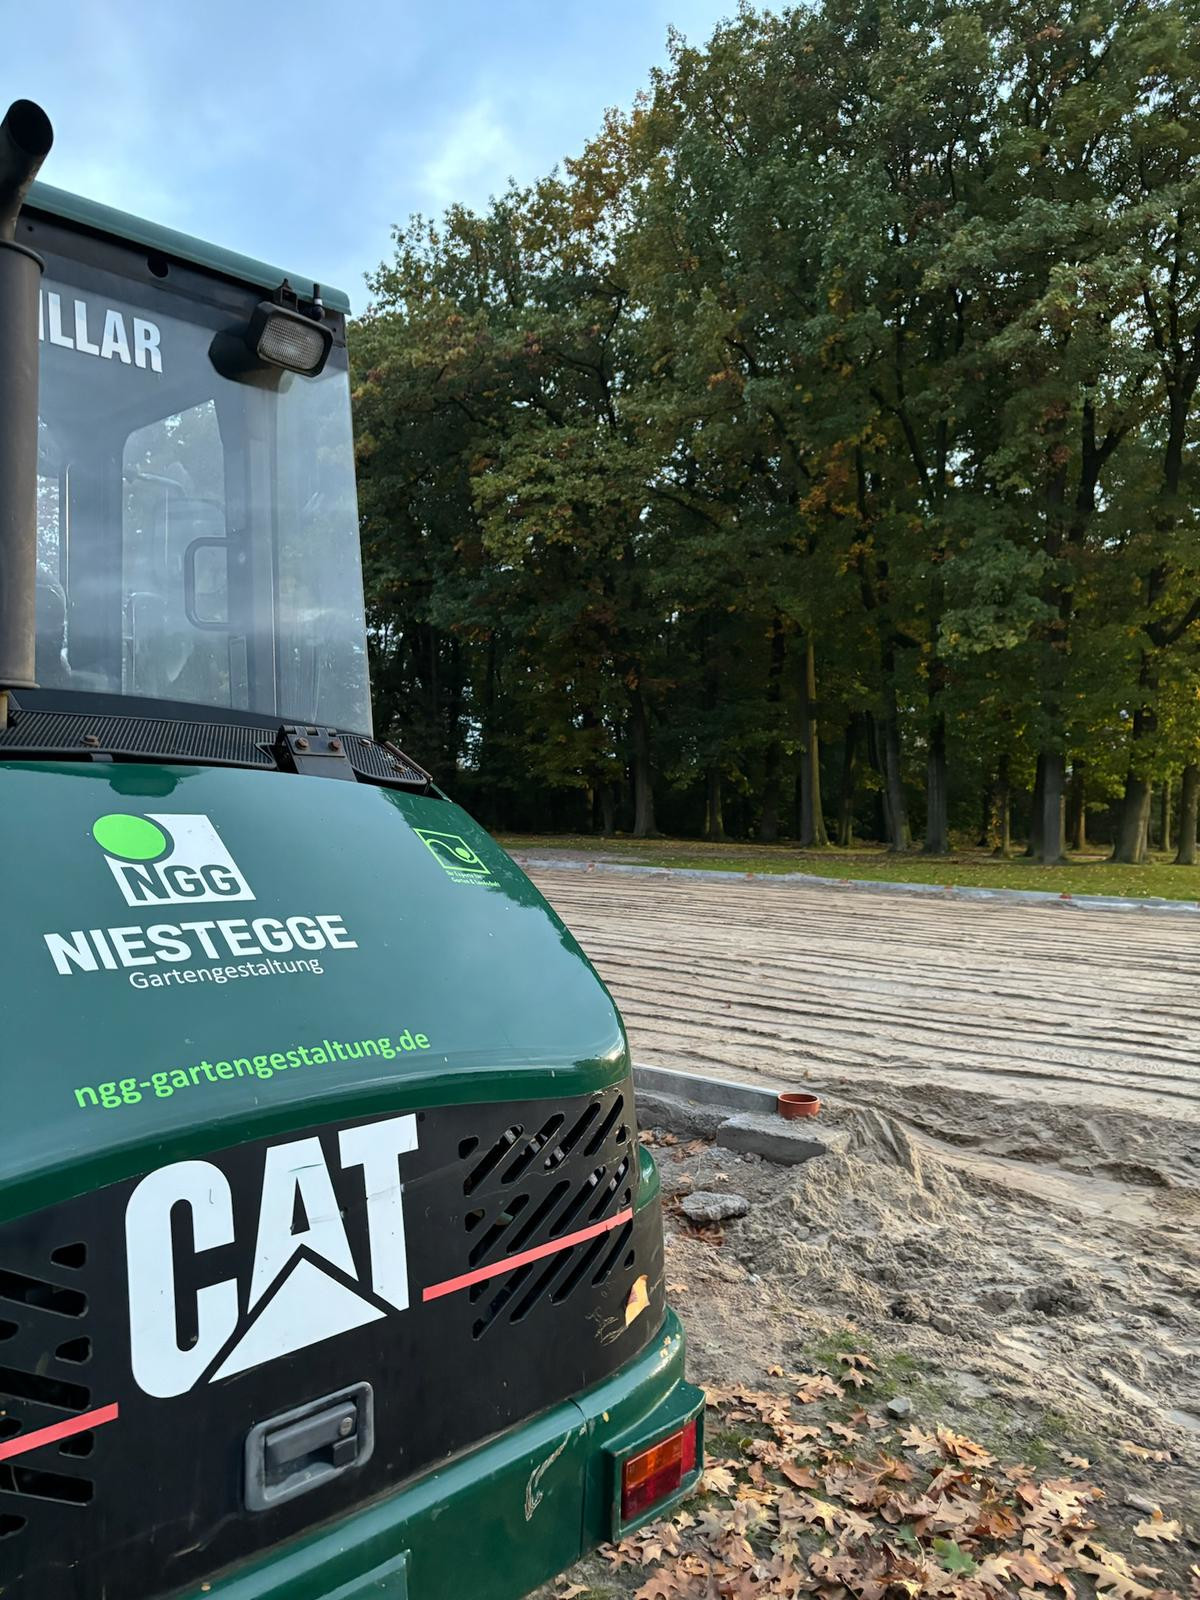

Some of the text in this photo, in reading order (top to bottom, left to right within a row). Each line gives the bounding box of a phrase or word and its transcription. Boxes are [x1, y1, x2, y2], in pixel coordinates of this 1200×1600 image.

[120, 864, 242, 901] NGG
[43, 914, 358, 975] NIESTEGGE
[128, 956, 324, 989] Gartengestaltung
[74, 1029, 431, 1108] ngg-gartengestaltung.de
[125, 1113, 419, 1398] CAT
